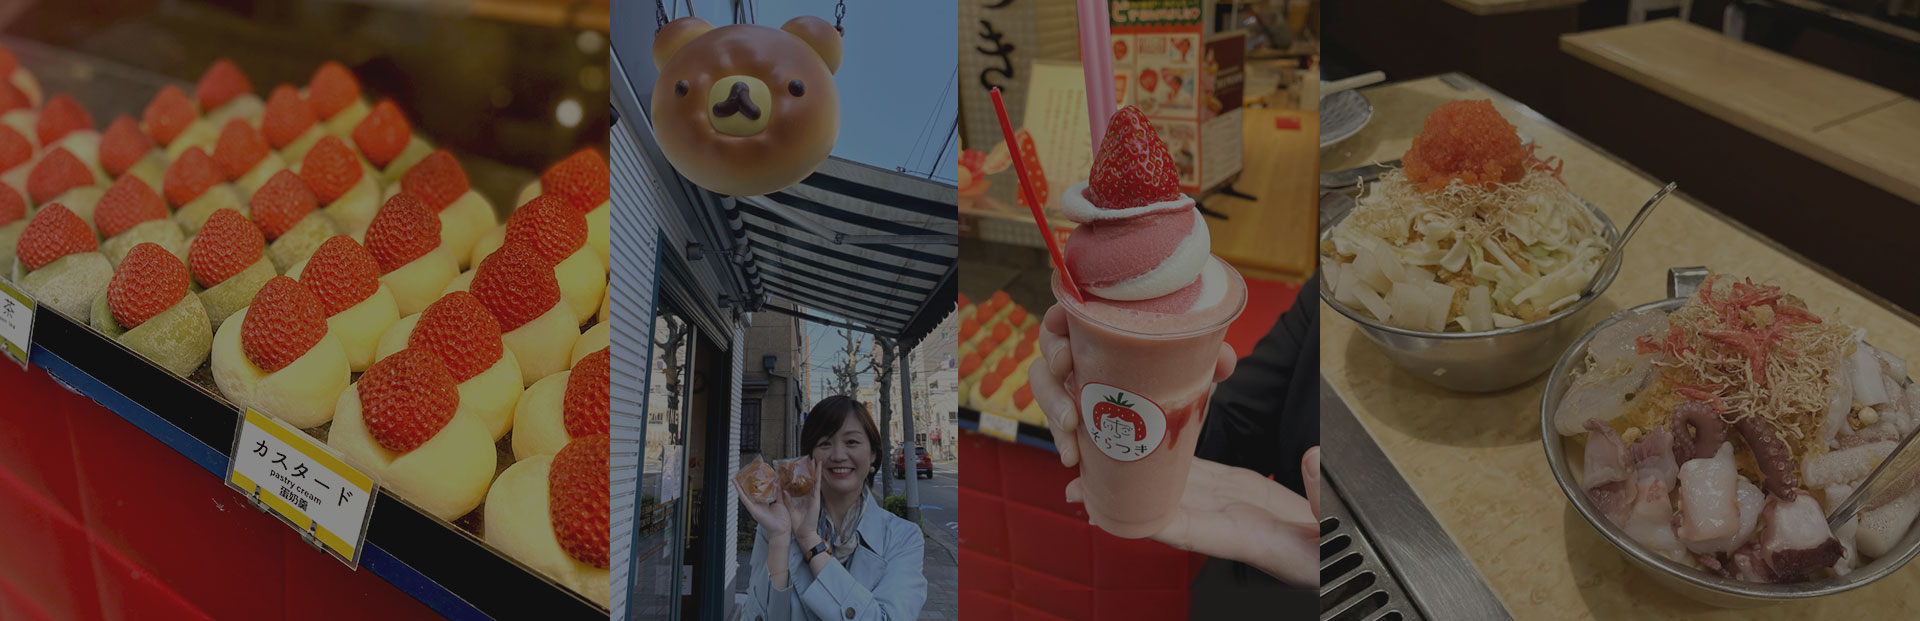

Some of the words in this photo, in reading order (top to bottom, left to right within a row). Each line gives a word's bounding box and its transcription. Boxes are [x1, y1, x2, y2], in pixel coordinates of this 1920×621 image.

[253, 440, 353, 506] カスタード
[269, 468, 296, 489] pastry
[296, 485, 322, 505] cream
